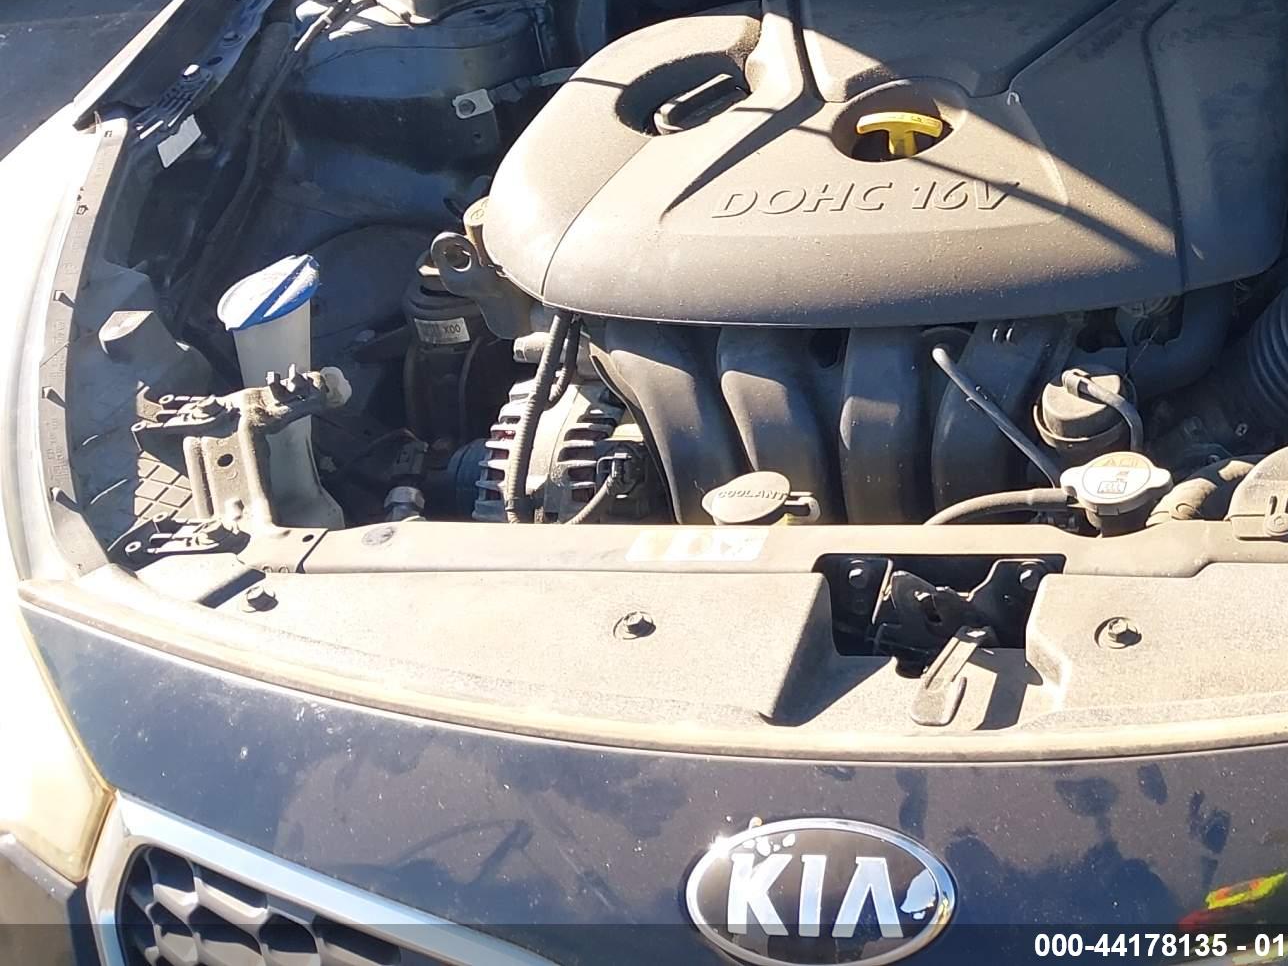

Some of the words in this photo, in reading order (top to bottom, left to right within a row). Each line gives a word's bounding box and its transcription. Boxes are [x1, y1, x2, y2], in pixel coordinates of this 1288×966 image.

[711, 182, 893, 219] DOHC
[912, 181, 1020, 211] 16V
[718, 489, 788, 501] COOLANT
[727, 853, 904, 938] KIA
